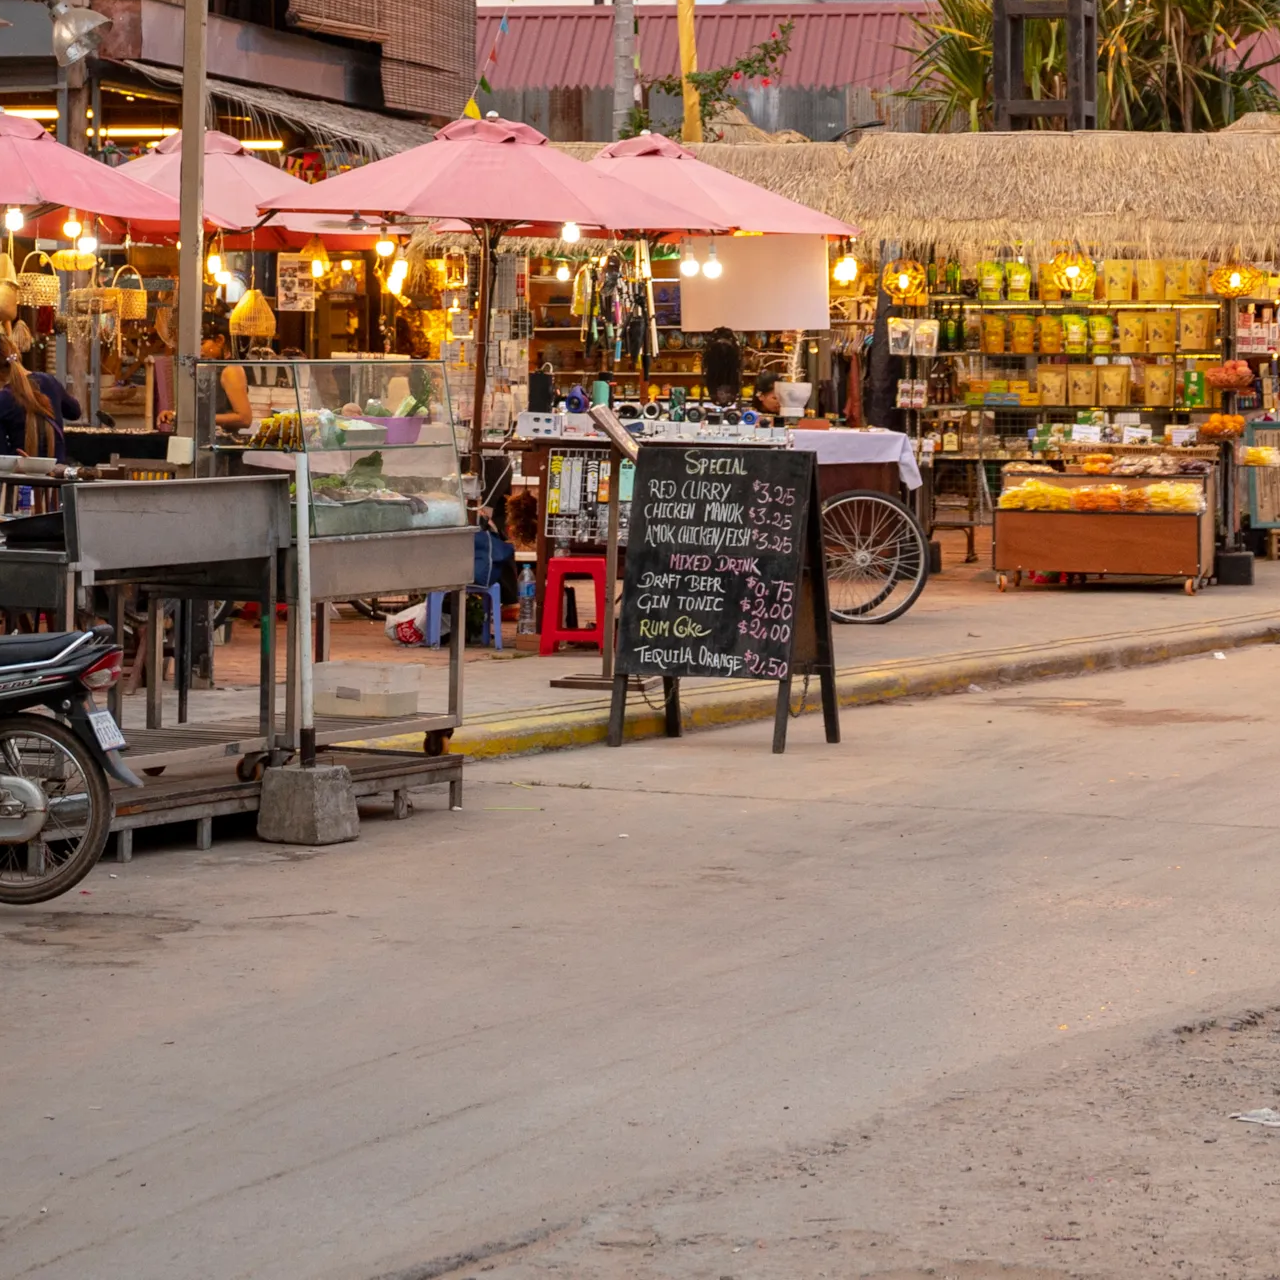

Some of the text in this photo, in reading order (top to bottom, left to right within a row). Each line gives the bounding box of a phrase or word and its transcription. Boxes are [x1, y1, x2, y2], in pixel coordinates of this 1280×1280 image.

[648, 479, 796, 507] RED CURRY $3.25
[644, 501, 793, 531] CHICKEN MANOK $3.25
[644, 524, 793, 554] AMOK CHICKEN/FISH $3.25
[670, 553, 762, 576] MIXED DRINK
[637, 571, 794, 602] DRAFT BEER $0.75
[636, 593, 793, 620] GIN TONIC $2.00
[639, 619, 670, 639] RUM
[737, 619, 792, 643] $2.00
[698, 645, 743, 677] ORANGE
[744, 650, 788, 678] $2.50
